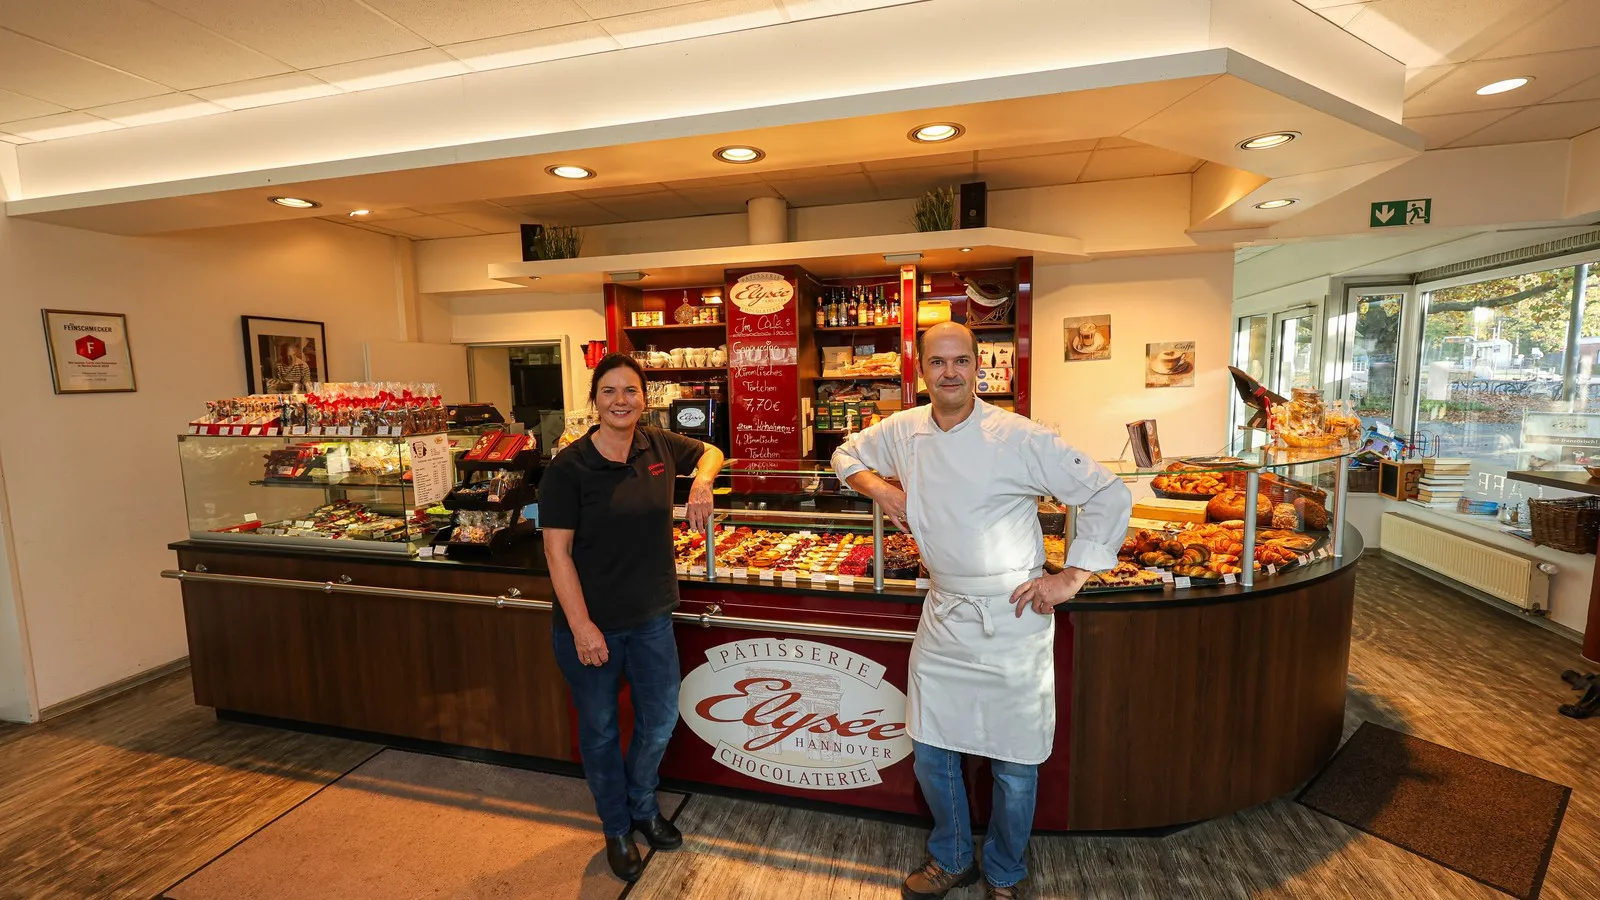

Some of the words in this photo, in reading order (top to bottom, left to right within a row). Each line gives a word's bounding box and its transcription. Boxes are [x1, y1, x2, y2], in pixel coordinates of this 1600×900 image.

[735, 283, 790, 307] Elysée
[64, 324, 112, 332] FEINSCHMECKER
[86, 341, 95, 354] F
[734, 364, 783, 378] Himmlisches
[743, 397, 781, 413] 7,70€
[719, 641, 871, 678] PÂTISSERIE
[694, 677, 906, 752] Elysée
[795, 737, 892, 760] HANNOVER
[720, 748, 872, 787] CHOCOLATERIE
